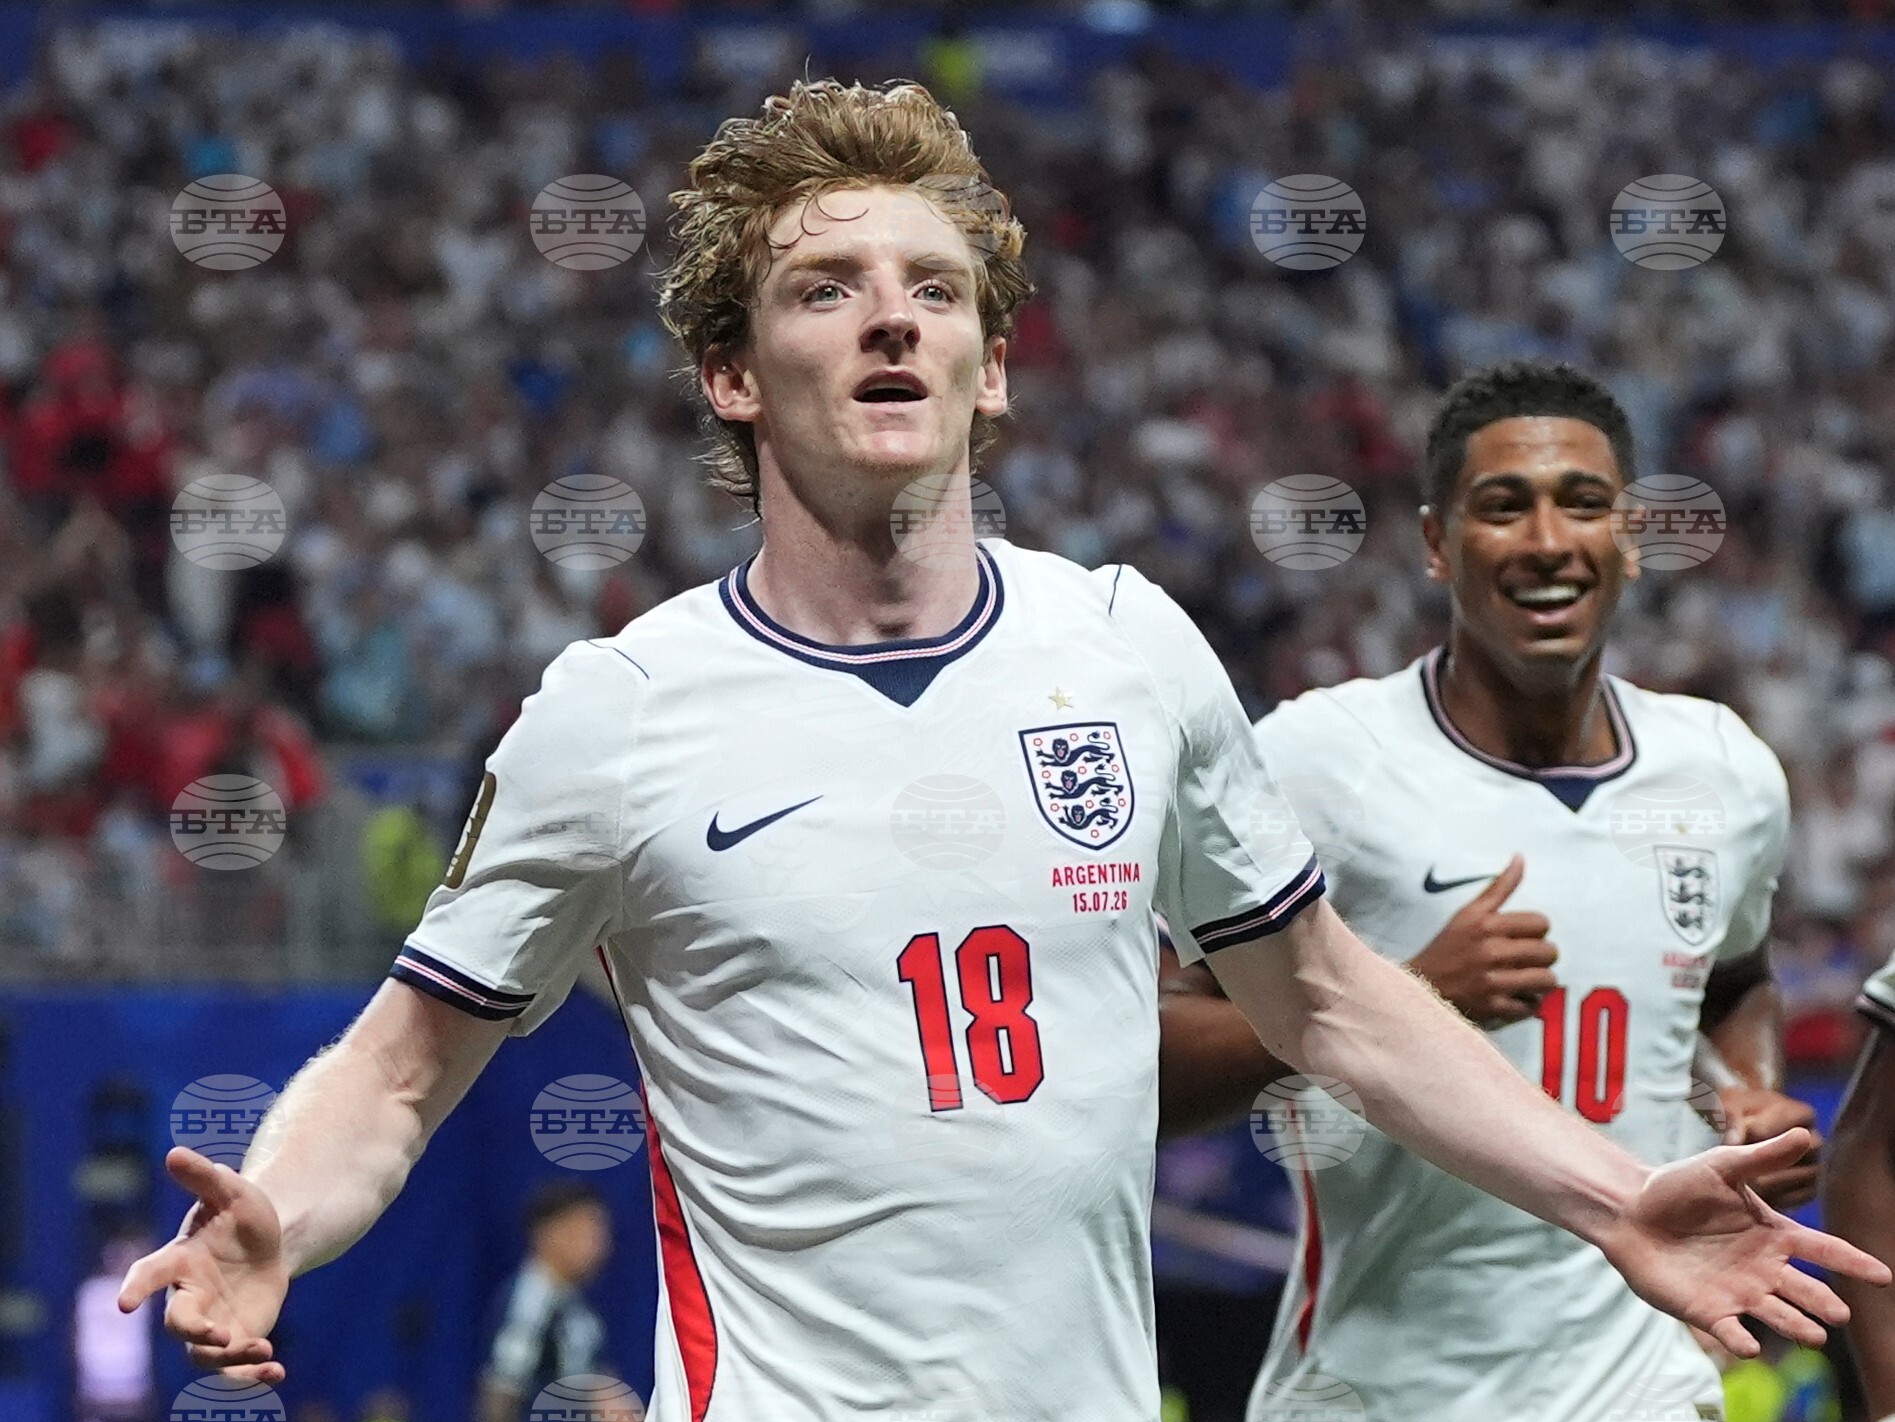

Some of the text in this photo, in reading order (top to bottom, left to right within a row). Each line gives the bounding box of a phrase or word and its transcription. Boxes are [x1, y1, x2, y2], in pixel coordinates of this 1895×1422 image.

[1052, 863, 1140, 887] ARGENTINA
[1073, 891, 1127, 913] 15.07.26
[896, 924, 1044, 1112] 18
[1538, 987, 1629, 1123] 10
